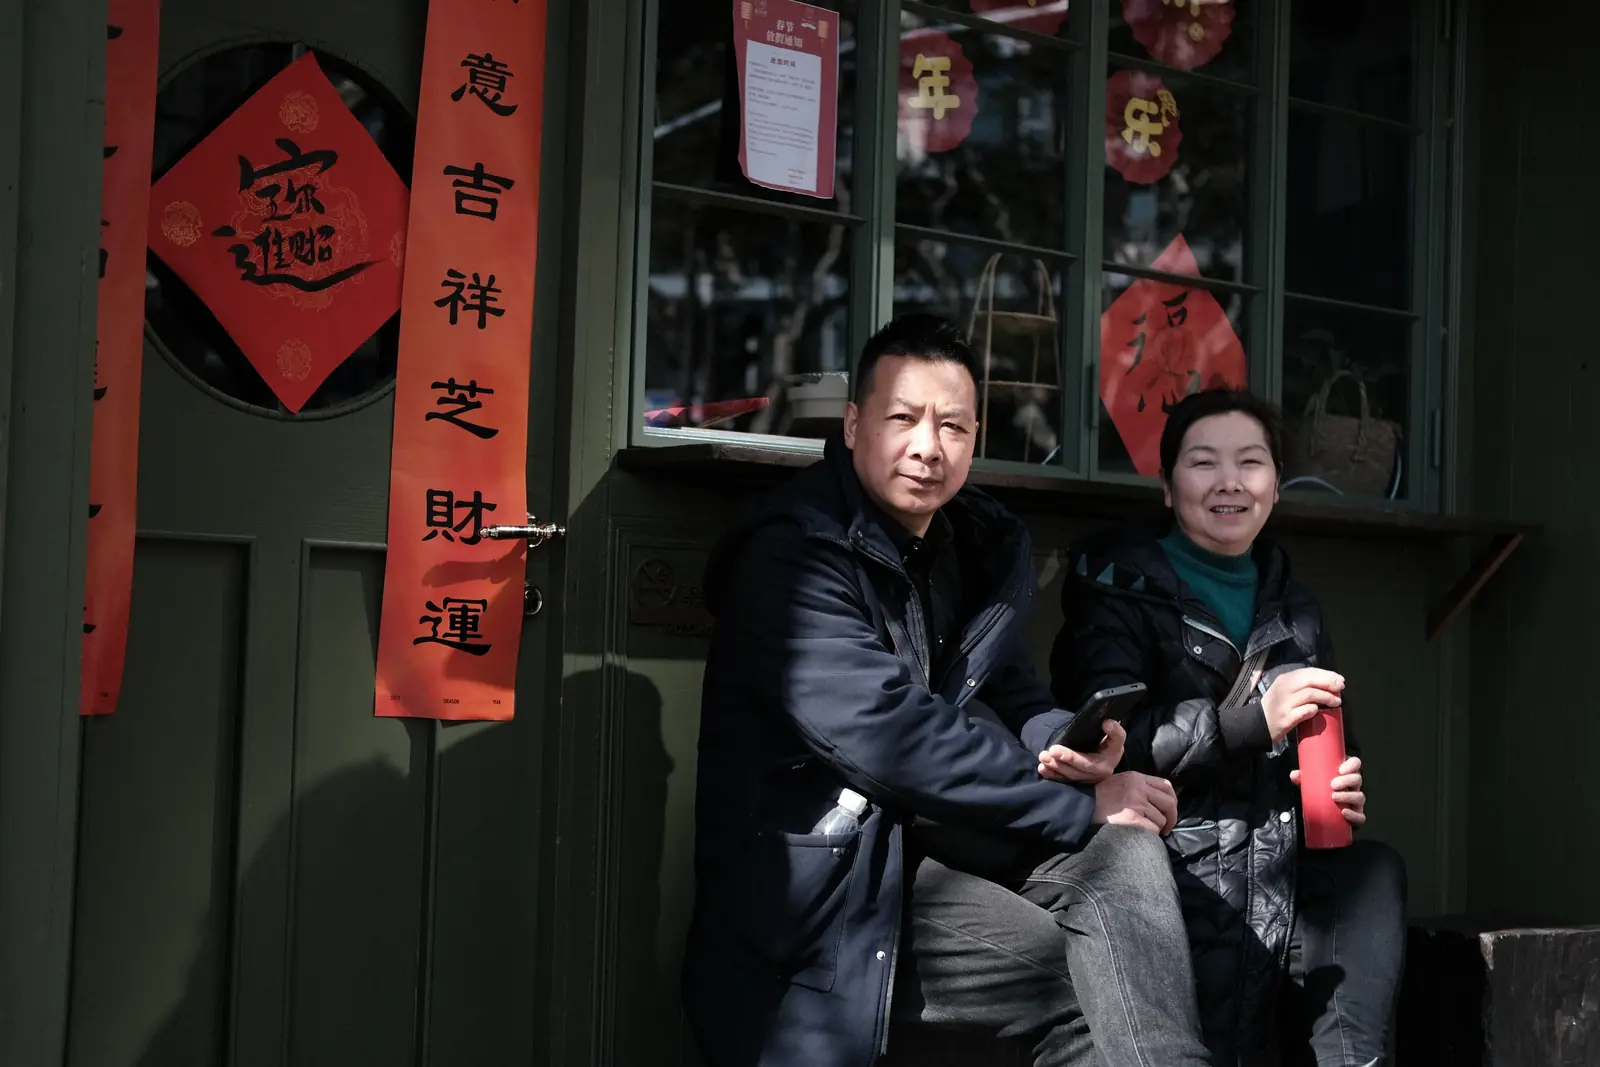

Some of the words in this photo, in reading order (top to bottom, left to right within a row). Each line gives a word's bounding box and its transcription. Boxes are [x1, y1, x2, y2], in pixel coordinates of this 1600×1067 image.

[765, 30, 804, 48] 放假通知
[775, 19, 795, 33] 春节
[907, 53, 961, 121] 年
[412, 0, 519, 656] 意吉祥芝財運
